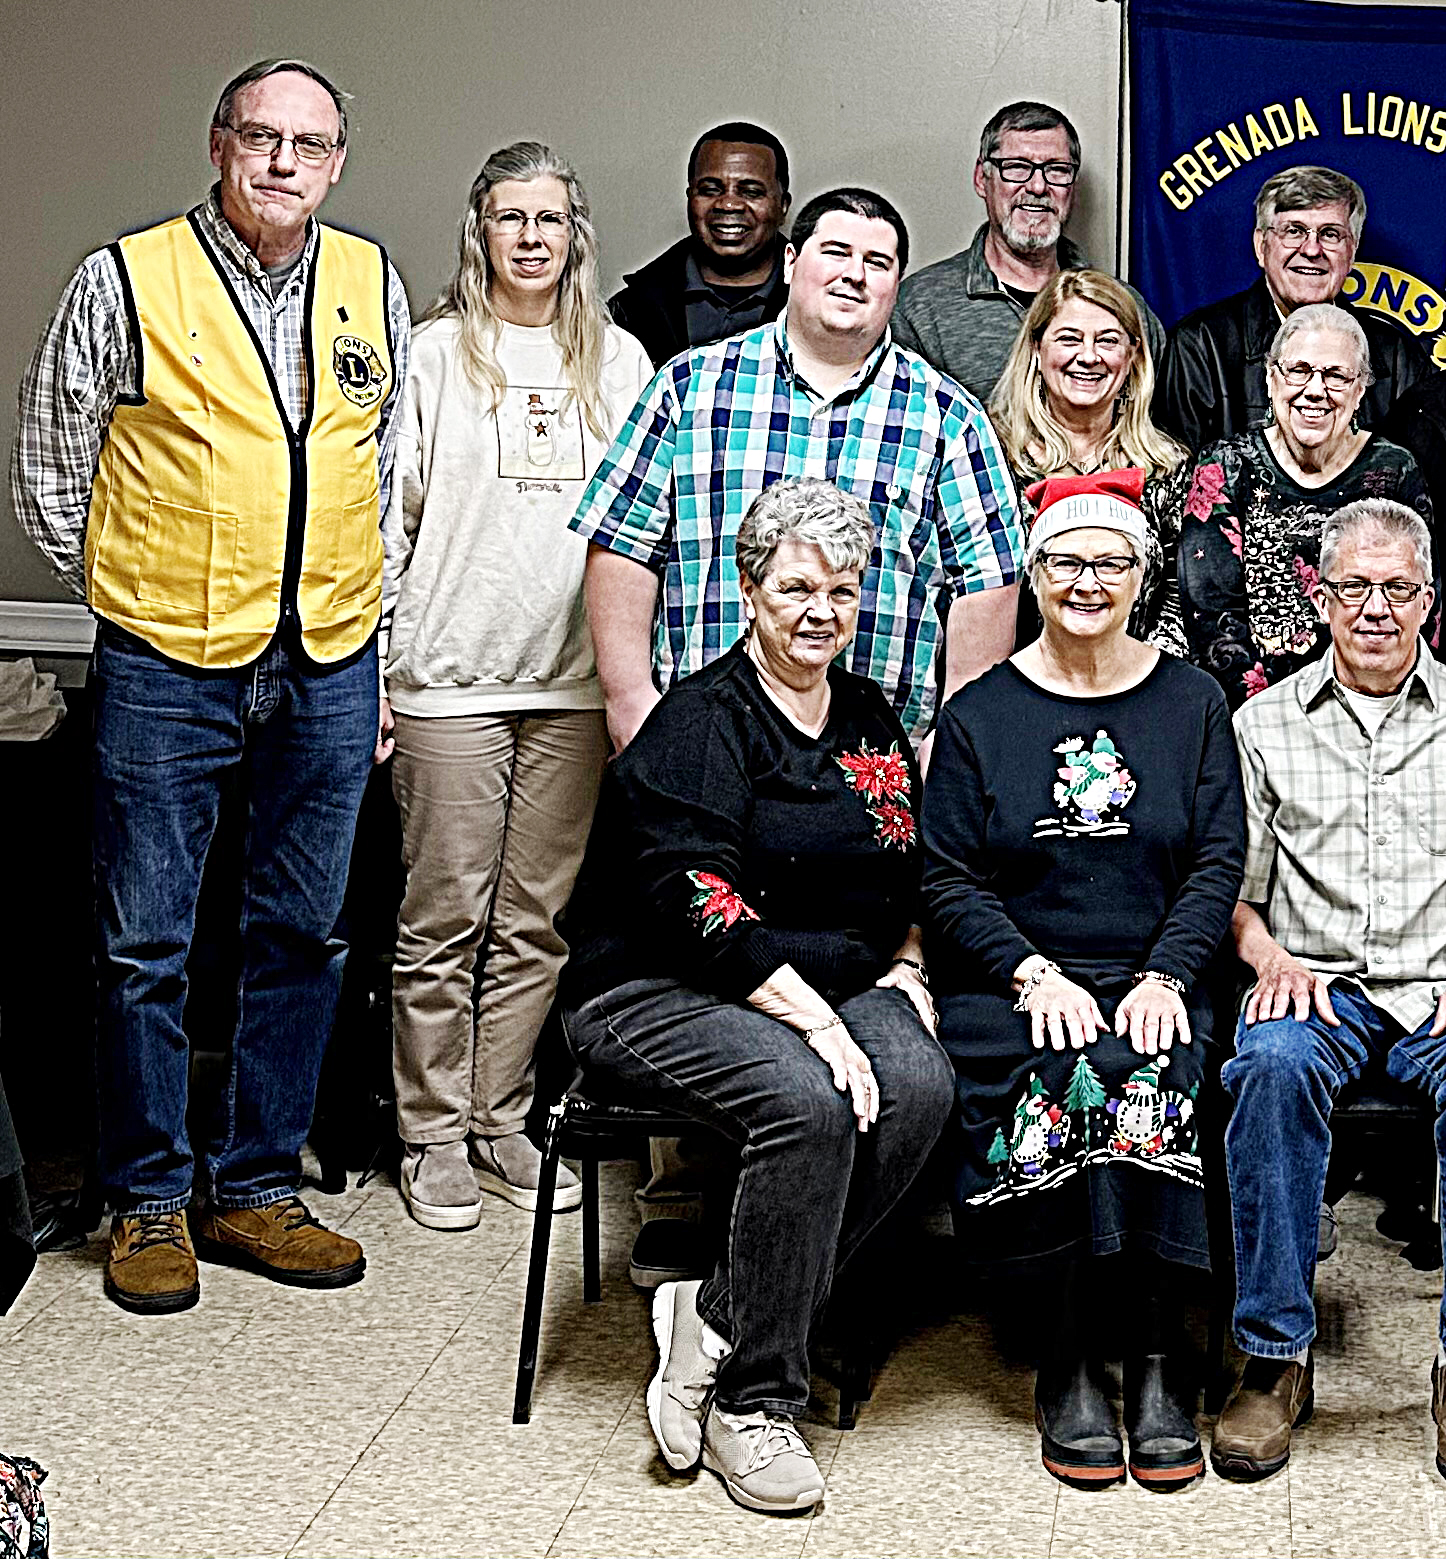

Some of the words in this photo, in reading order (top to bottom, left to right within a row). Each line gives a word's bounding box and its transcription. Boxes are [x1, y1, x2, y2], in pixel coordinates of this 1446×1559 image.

[1159, 97, 1319, 211] GRENADA
[1342, 267, 1438, 327] ONS
[336, 338, 369, 355] LIONS
[345, 356, 365, 382] L
